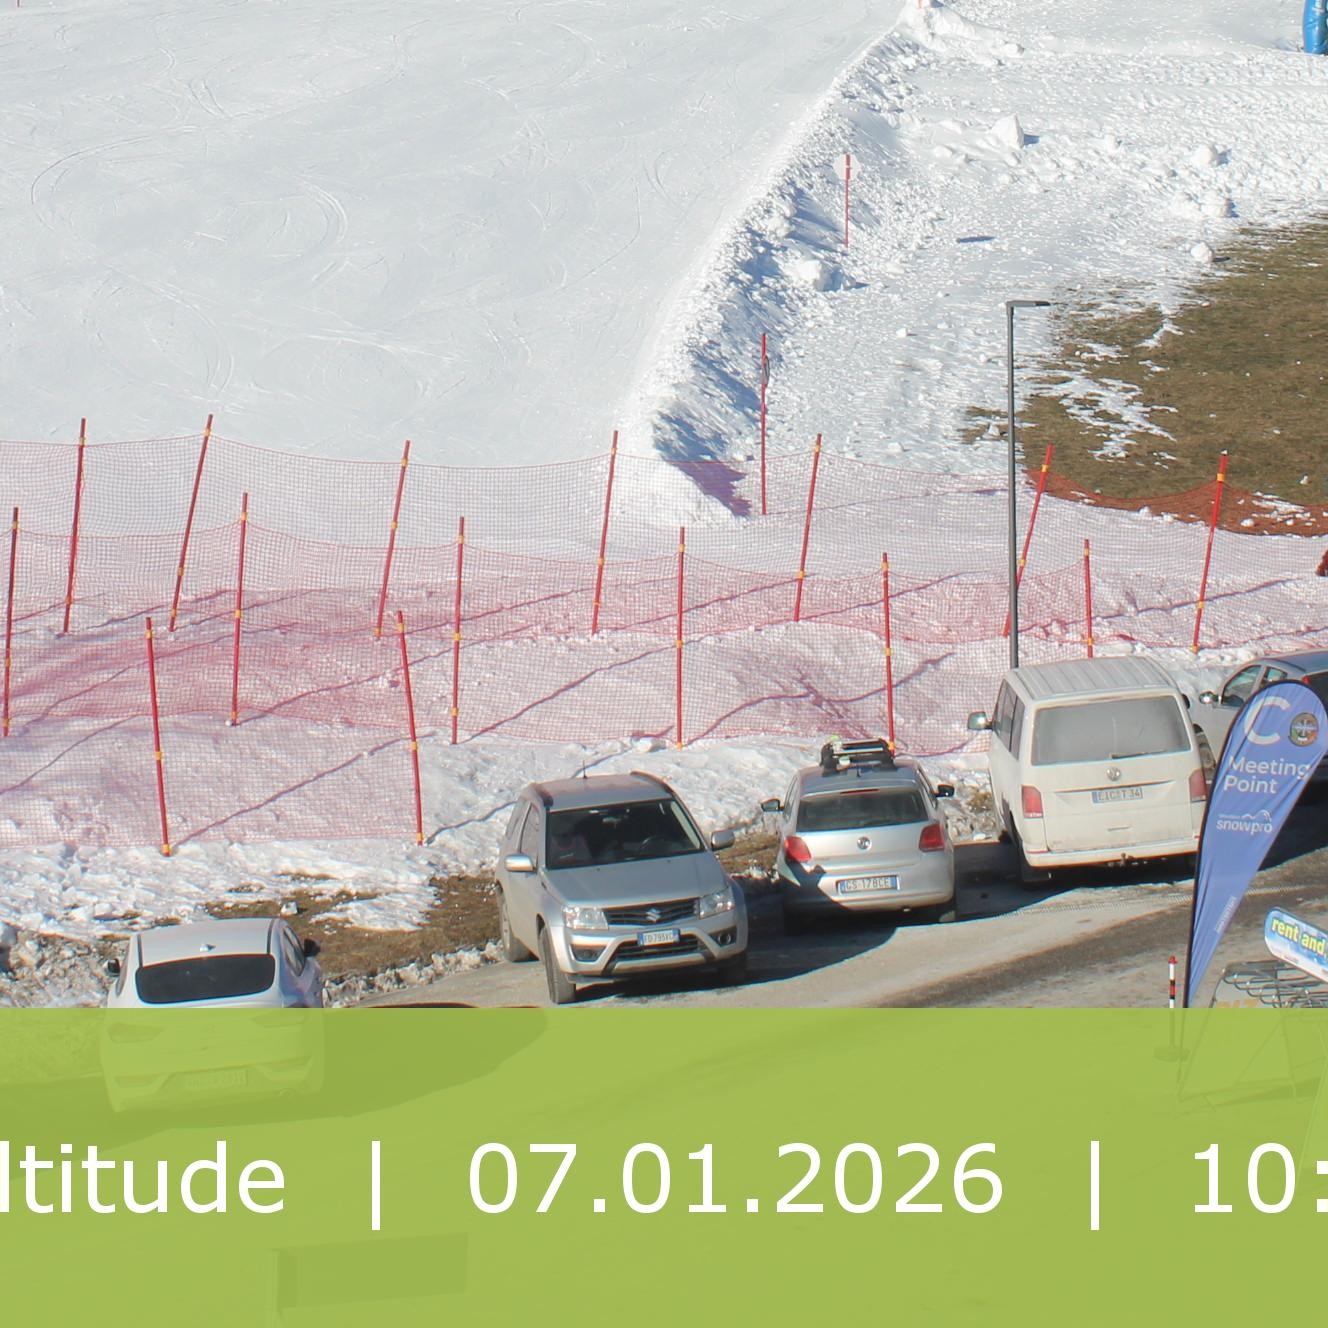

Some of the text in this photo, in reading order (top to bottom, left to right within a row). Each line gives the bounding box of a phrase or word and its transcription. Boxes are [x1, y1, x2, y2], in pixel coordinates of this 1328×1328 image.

[1229, 755, 1312, 781] Meeting
[1223, 774, 1278, 794] Point
[1216, 818, 1272, 835] snowpro
[1271, 918, 1299, 943] rent
[1301, 933, 1325, 956] and
